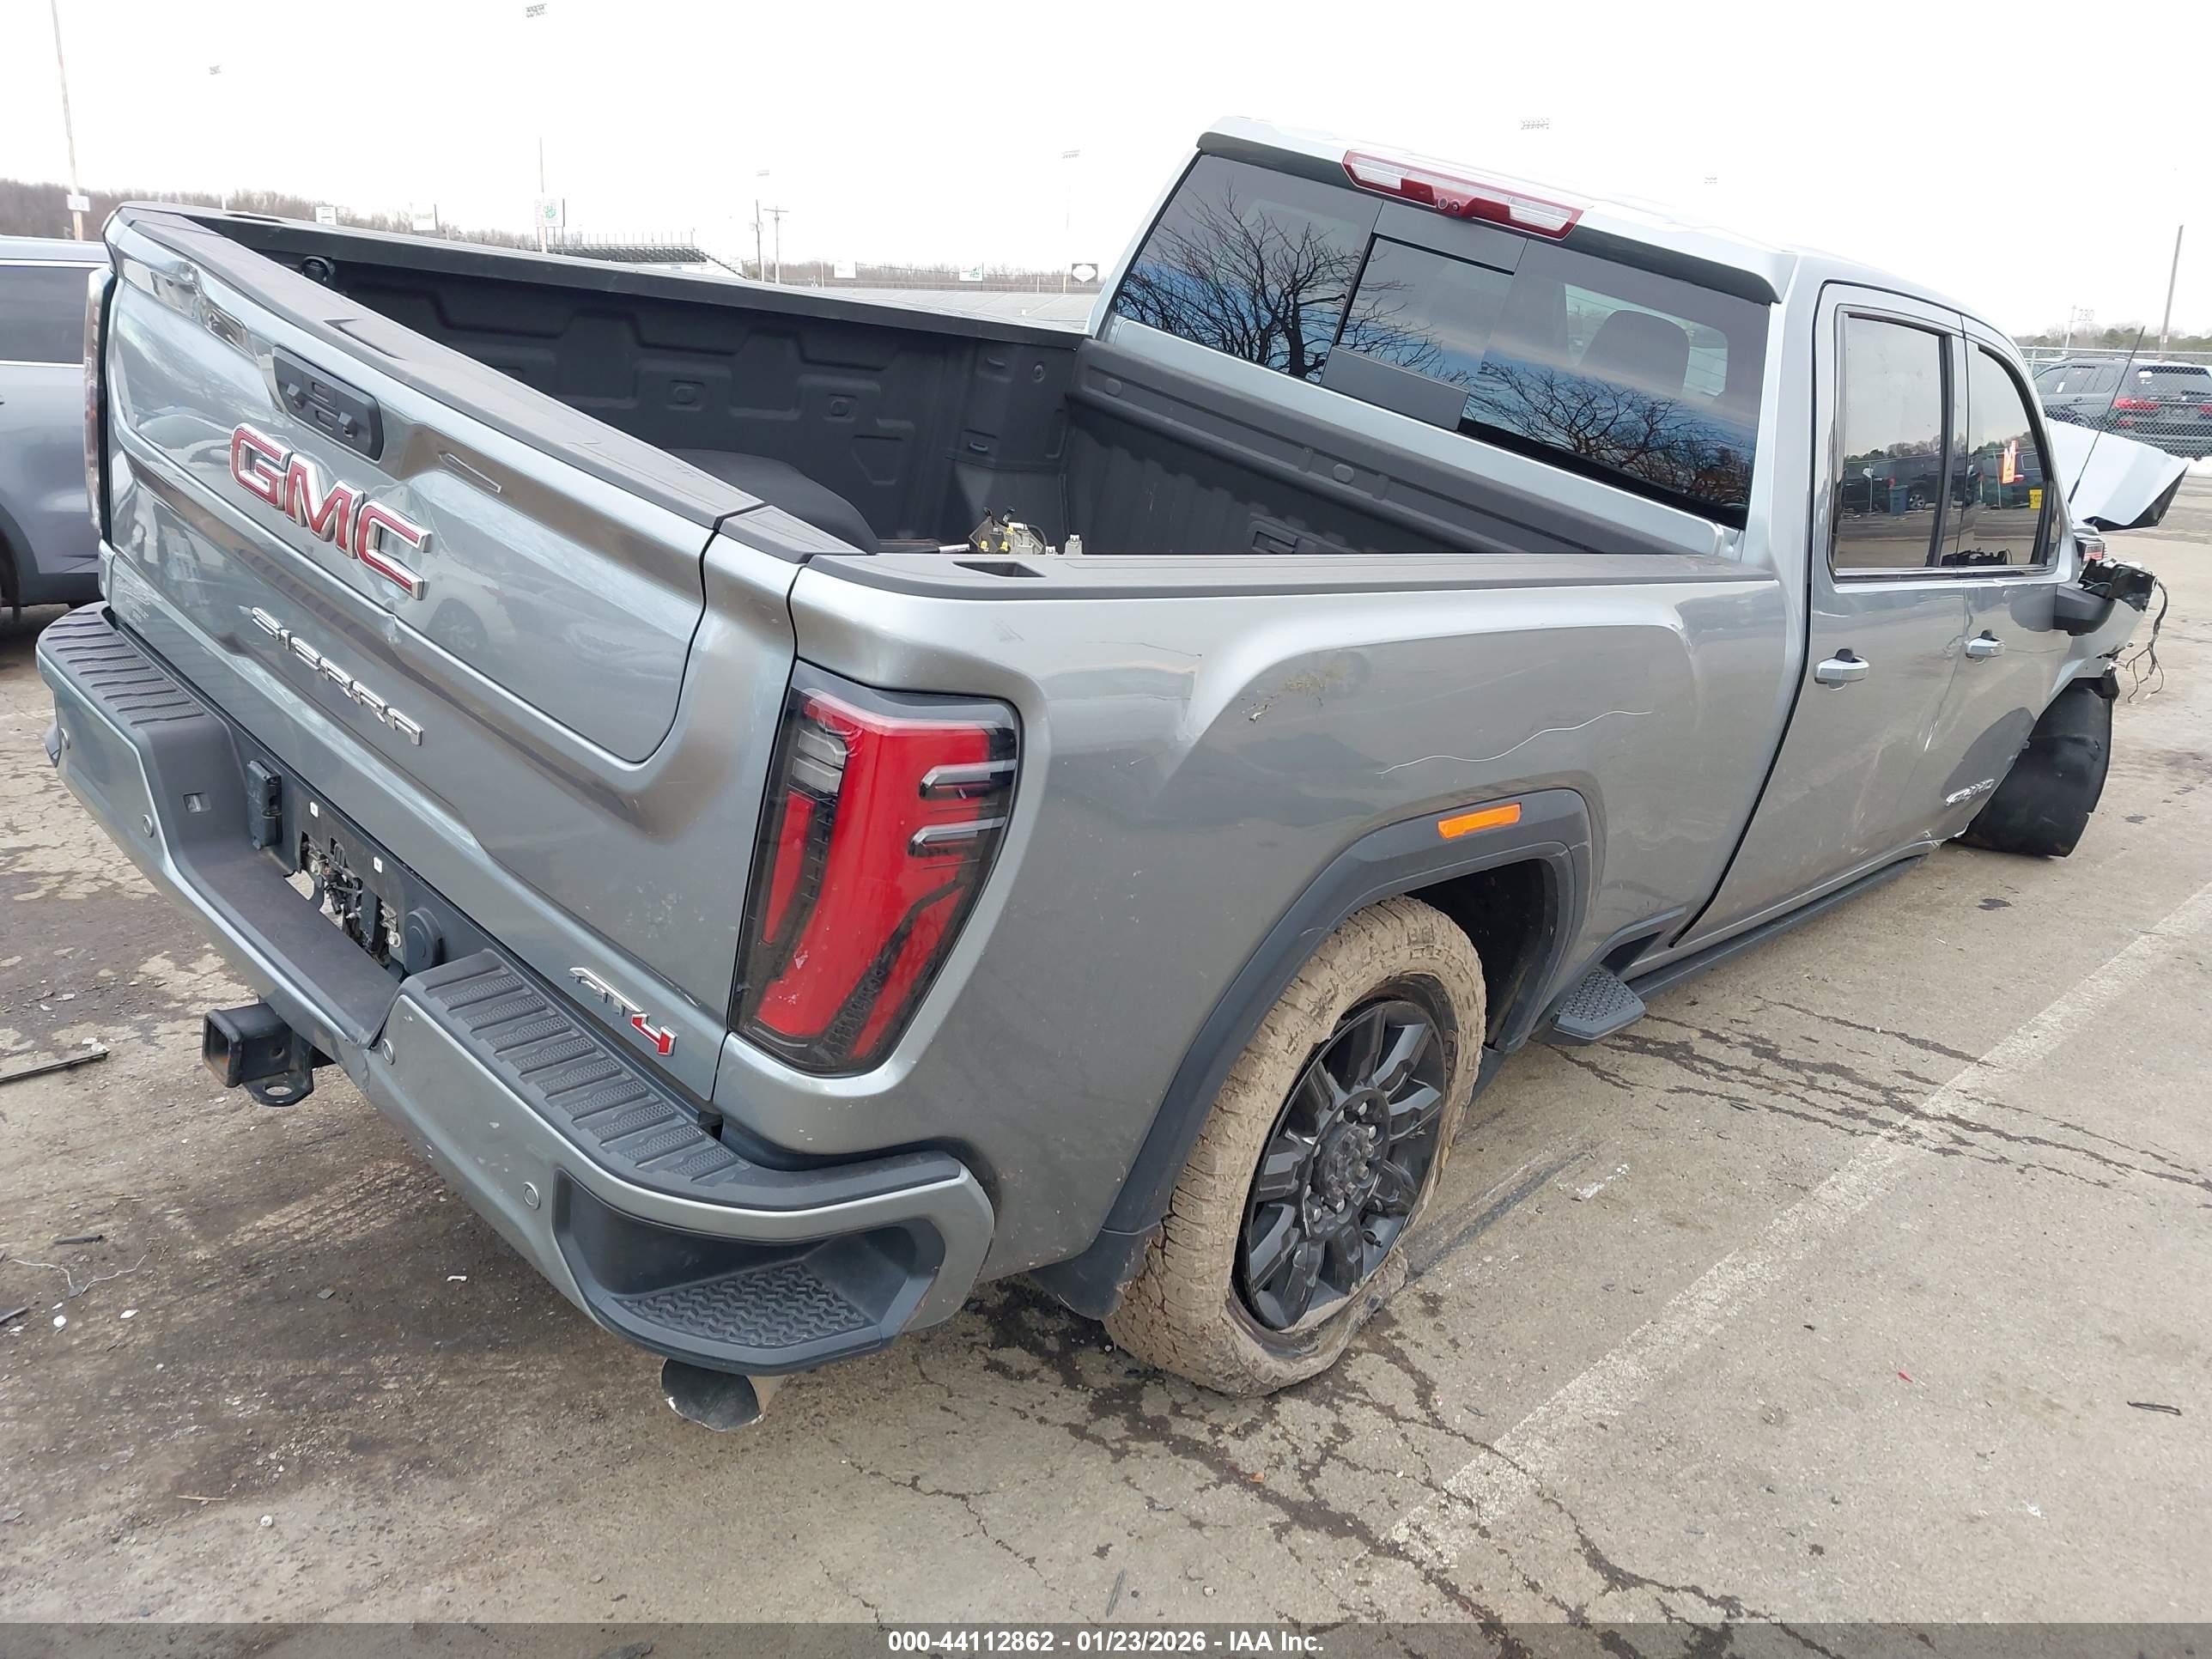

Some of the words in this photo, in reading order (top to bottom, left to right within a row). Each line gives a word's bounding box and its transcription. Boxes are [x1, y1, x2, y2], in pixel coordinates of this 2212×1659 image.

[2078, 308, 2094, 322] 230
[230, 422, 432, 600] GMC
[251, 606, 422, 745] SIERRA
[569, 967, 677, 1056] AT4
